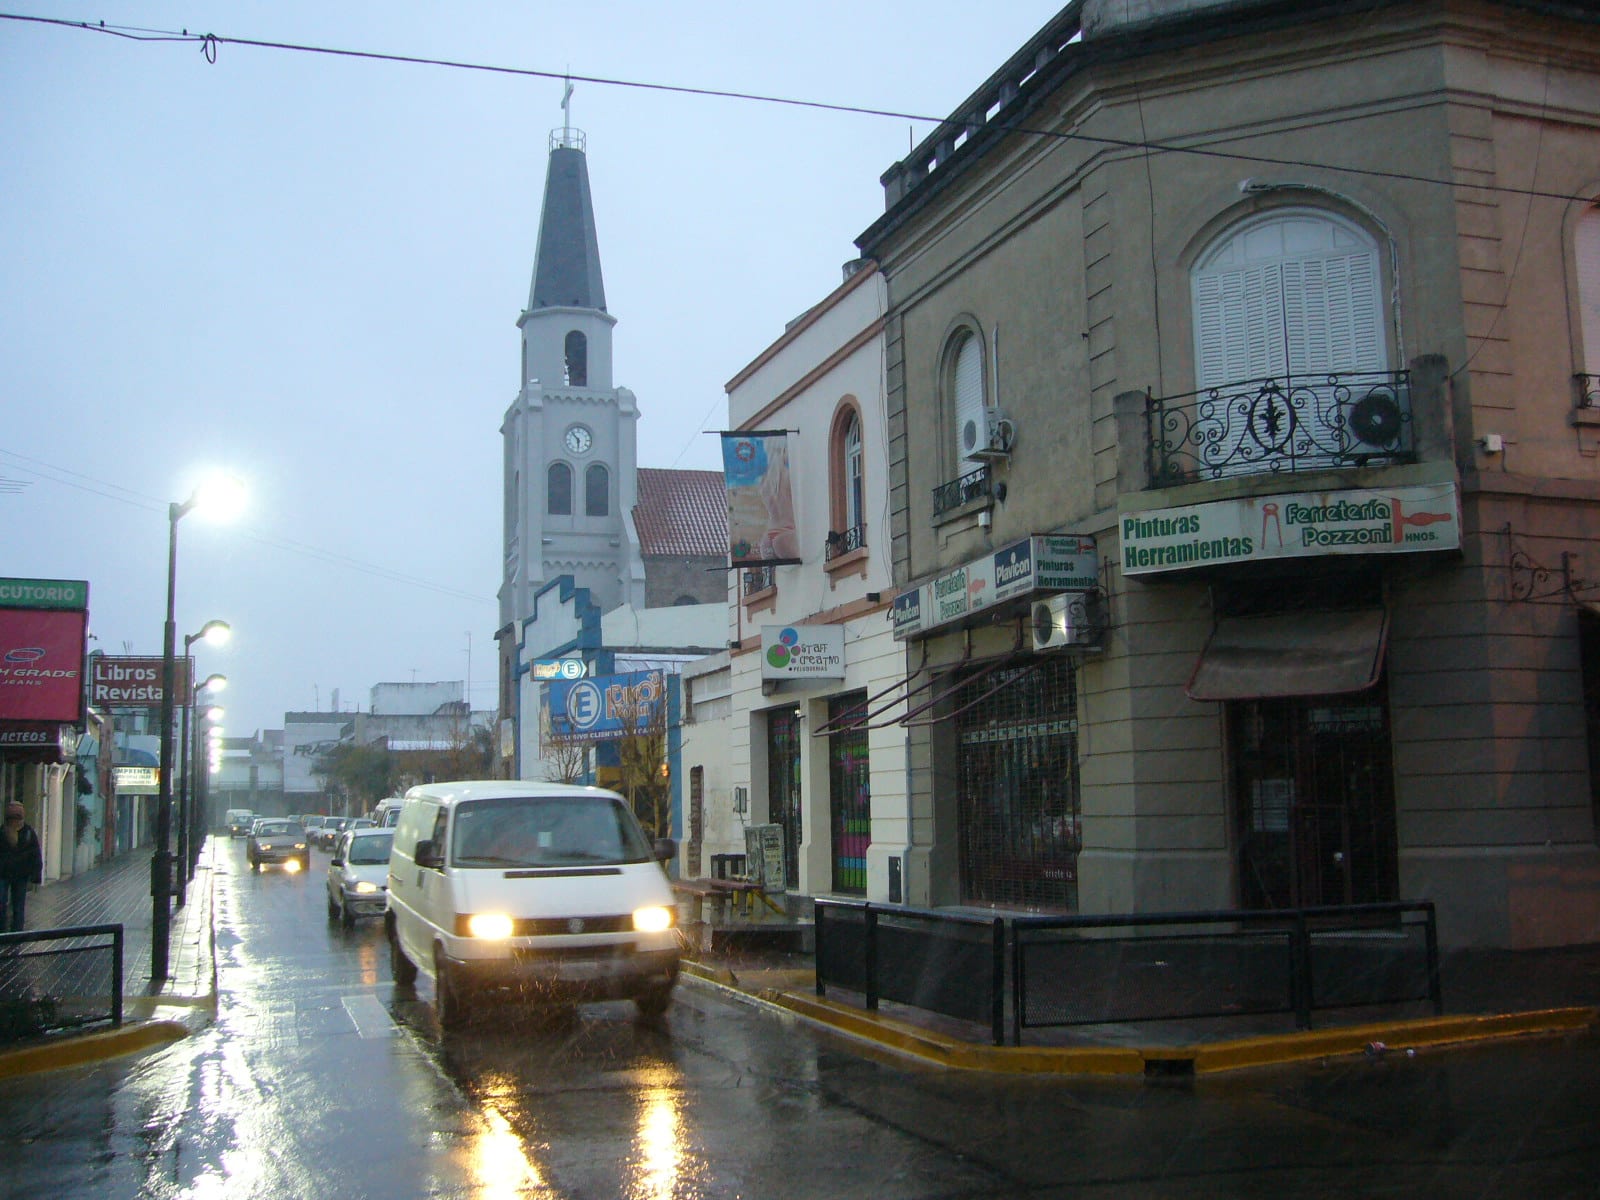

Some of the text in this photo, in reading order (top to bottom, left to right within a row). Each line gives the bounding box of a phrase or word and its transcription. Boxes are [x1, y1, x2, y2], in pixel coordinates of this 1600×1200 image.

[1285, 499, 1391, 525] Ferretería
[1123, 515, 1200, 540] Pinturas
[1302, 522, 1393, 548] Pozzoni
[1125, 537, 1253, 568] Herramientas
[996, 553, 1031, 581] Plavicon
[1037, 560, 1074, 572] Pinturas
[14, 669, 77, 678] GRADE
[96, 664, 156, 680] Libros
[95, 684, 175, 700] Revista
[575, 691, 593, 718] E
